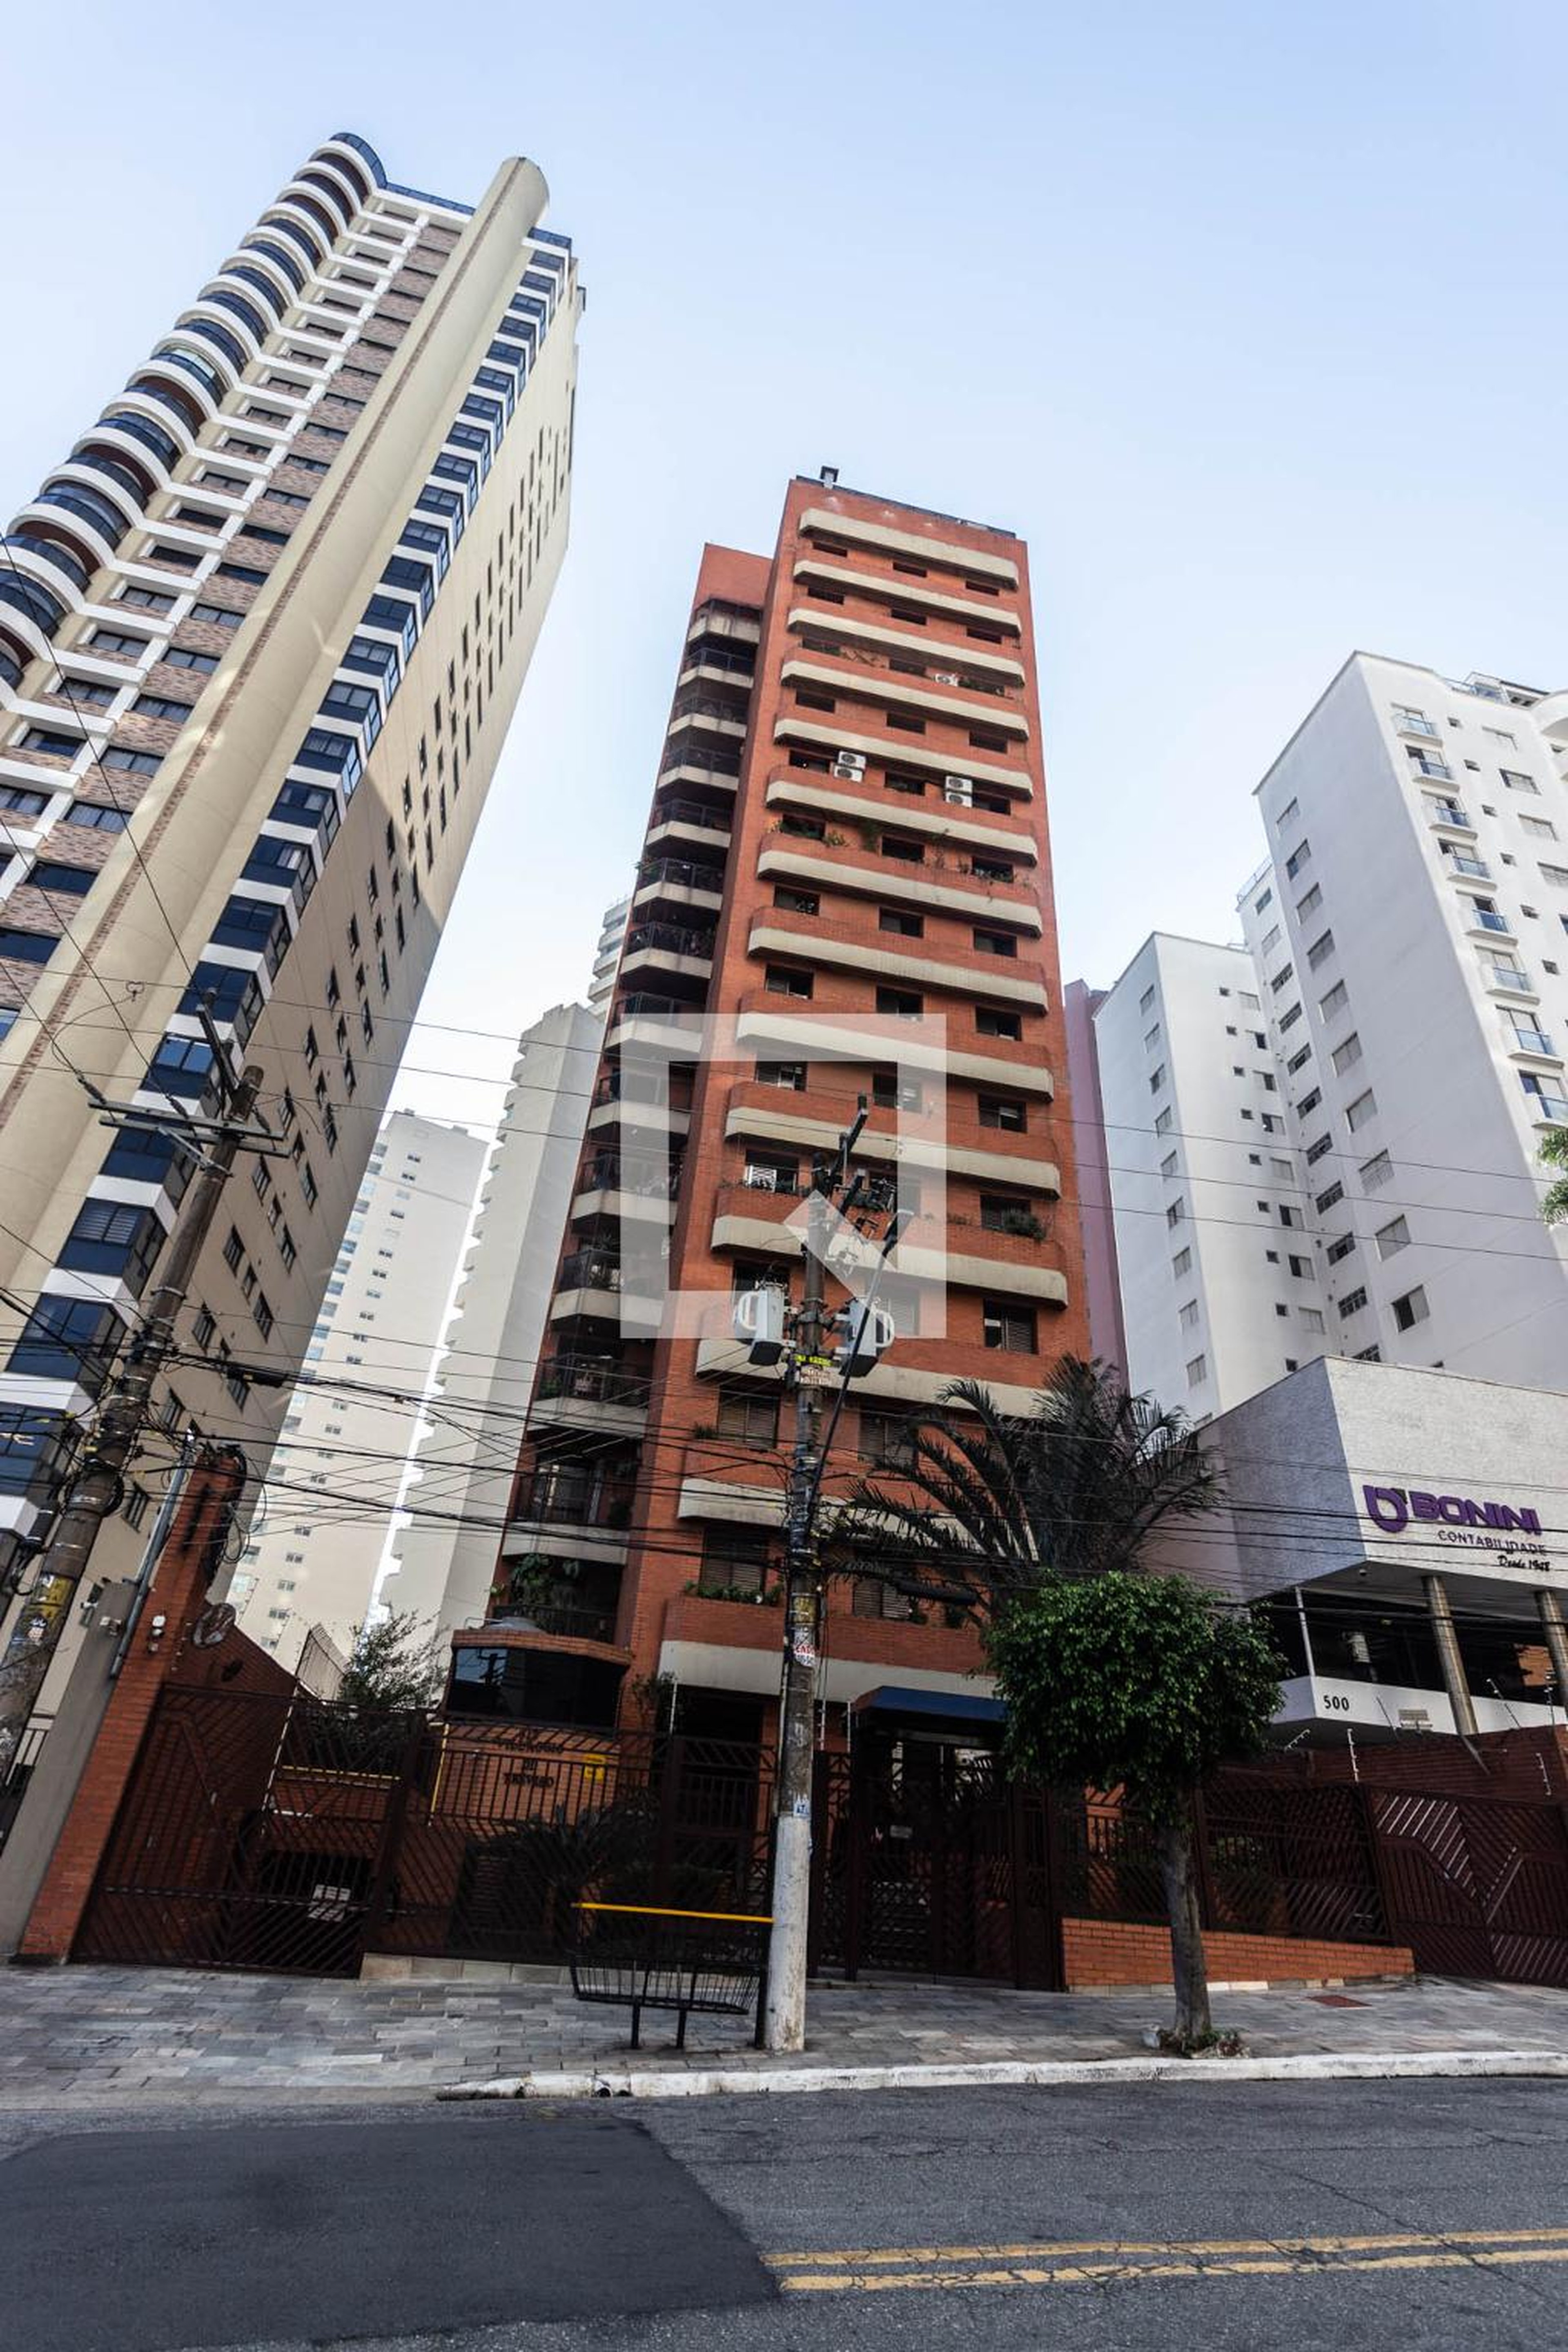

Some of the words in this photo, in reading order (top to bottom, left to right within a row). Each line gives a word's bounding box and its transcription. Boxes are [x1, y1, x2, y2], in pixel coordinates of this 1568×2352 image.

[1408, 1491, 1542, 1536] BONINI
[1438, 1530, 1548, 1555] CONTABILIDADE
[1323, 1695, 1349, 1711] 500
